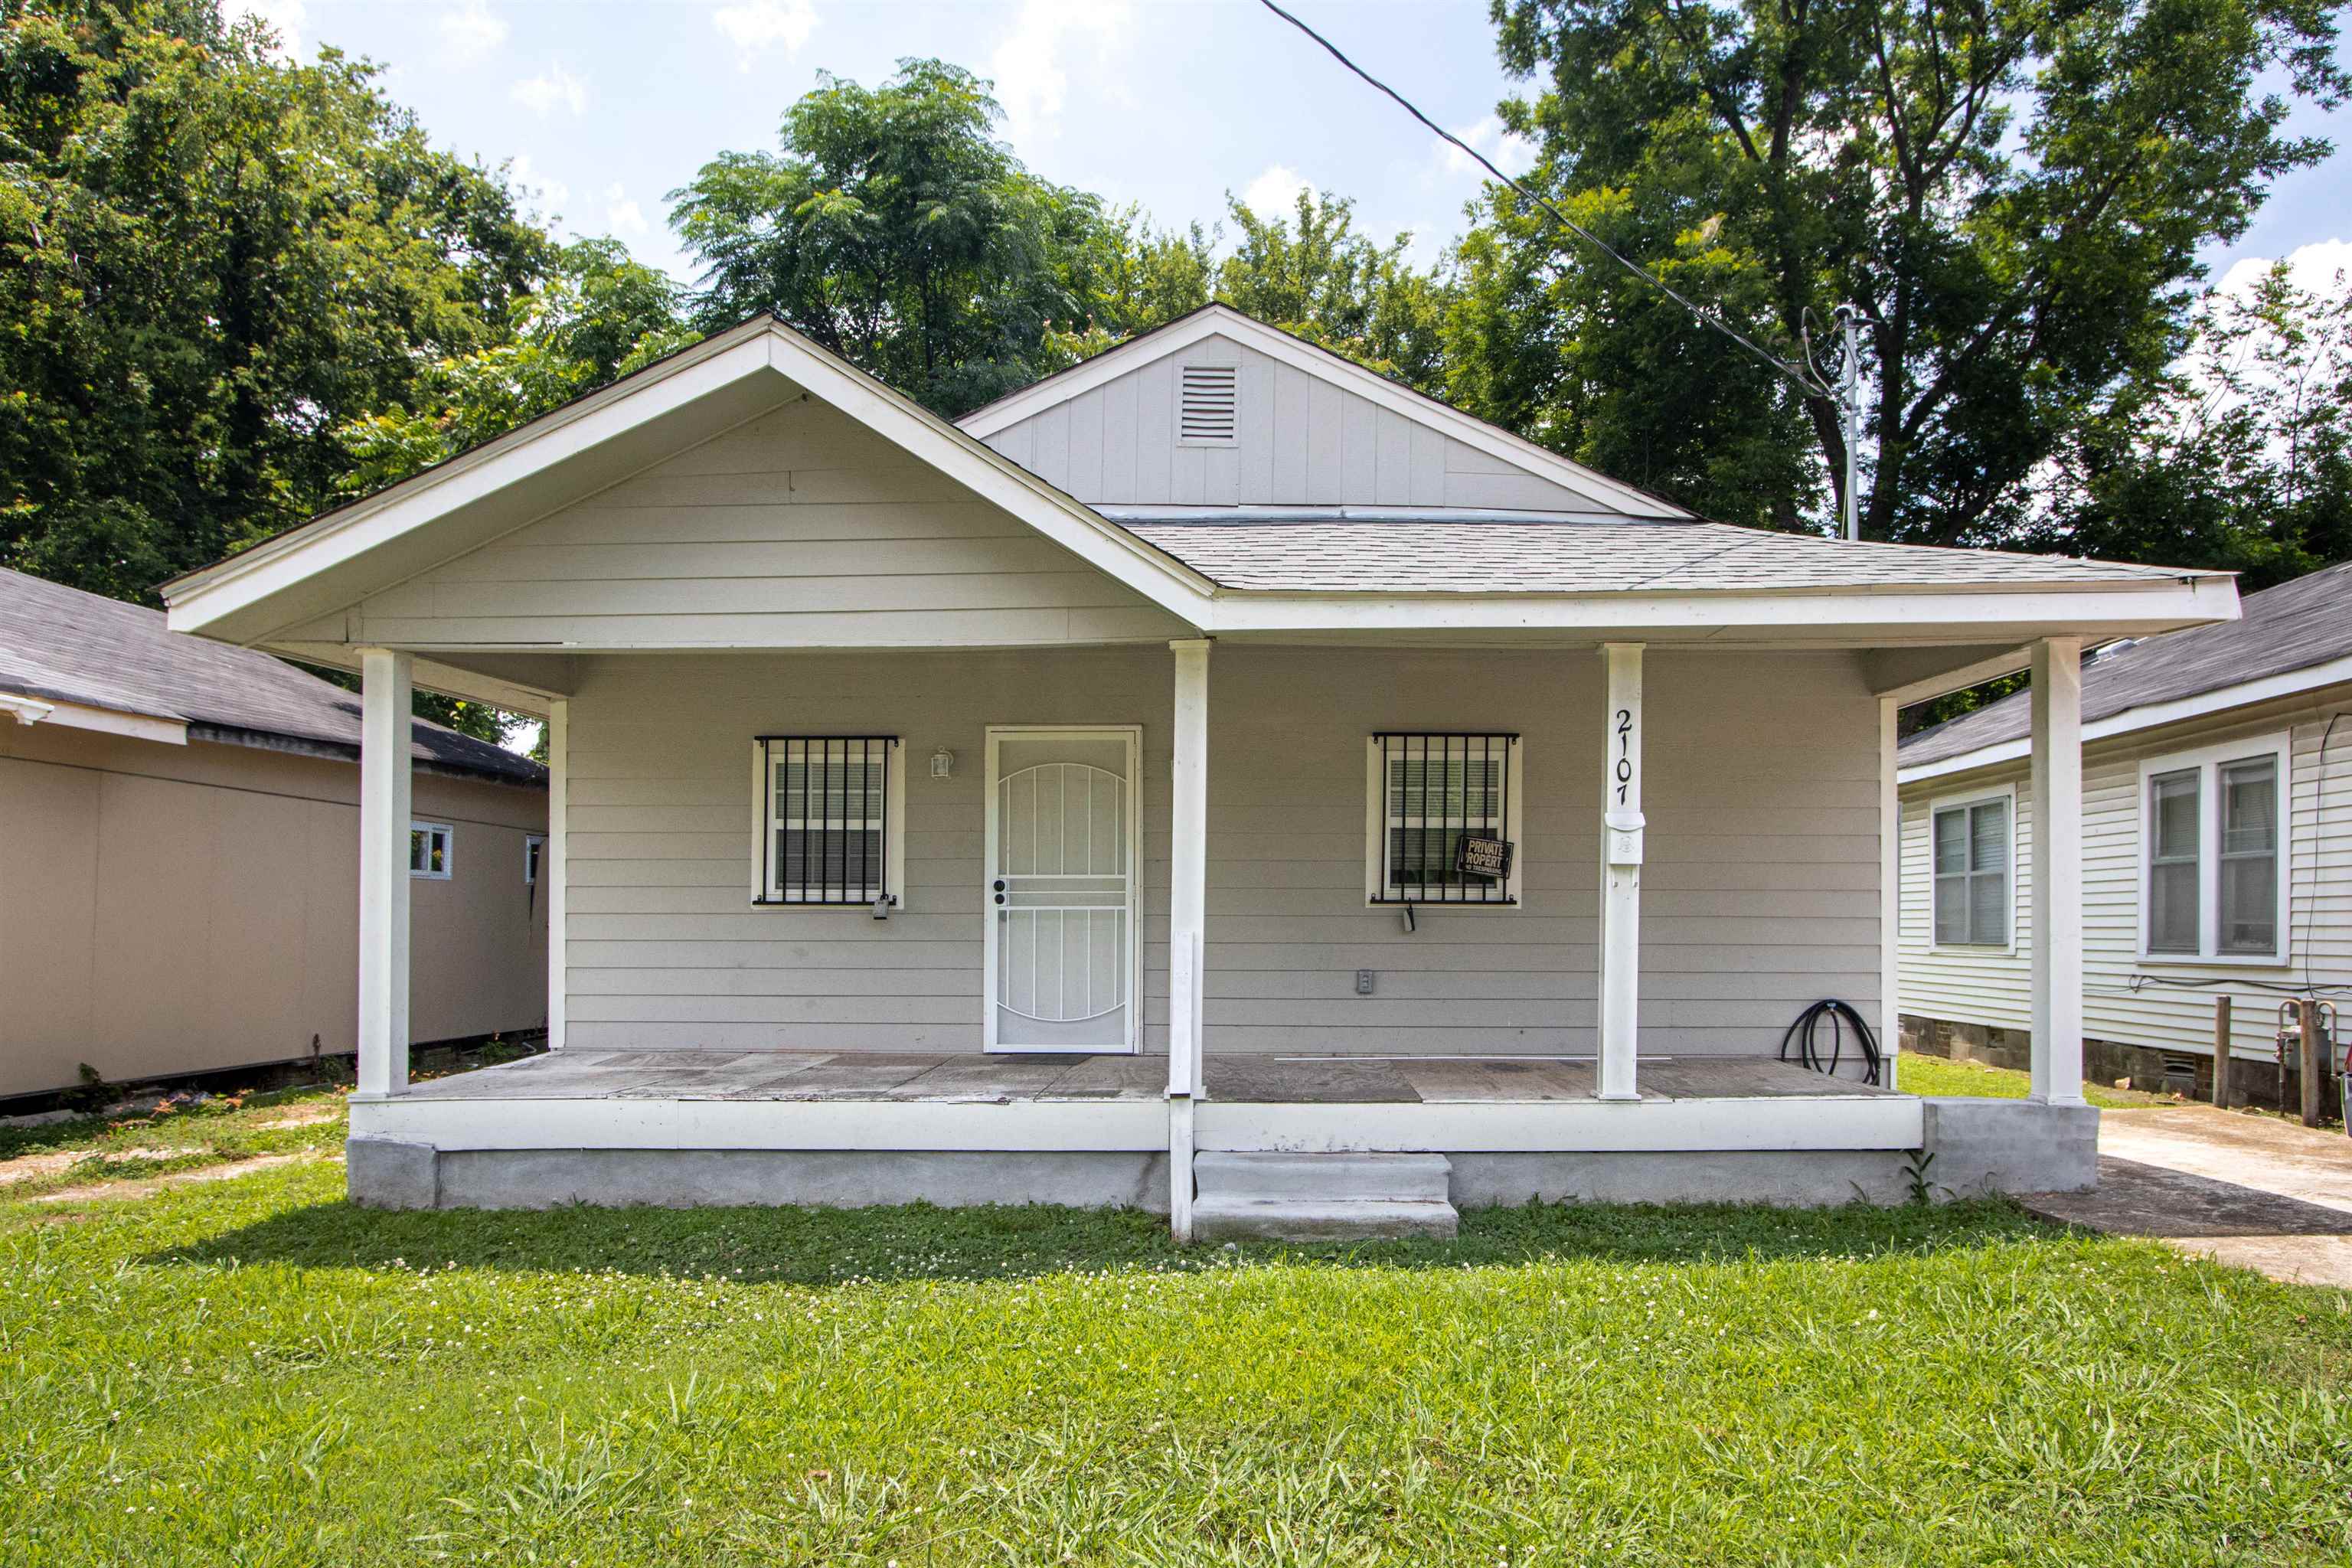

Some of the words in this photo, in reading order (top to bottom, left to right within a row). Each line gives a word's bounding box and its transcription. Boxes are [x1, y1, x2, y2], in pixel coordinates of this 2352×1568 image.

[1616, 709, 1632, 805] 2107
[1468, 840, 1504, 856] PRIVATE
[1465, 851, 1503, 868] ROPERT
